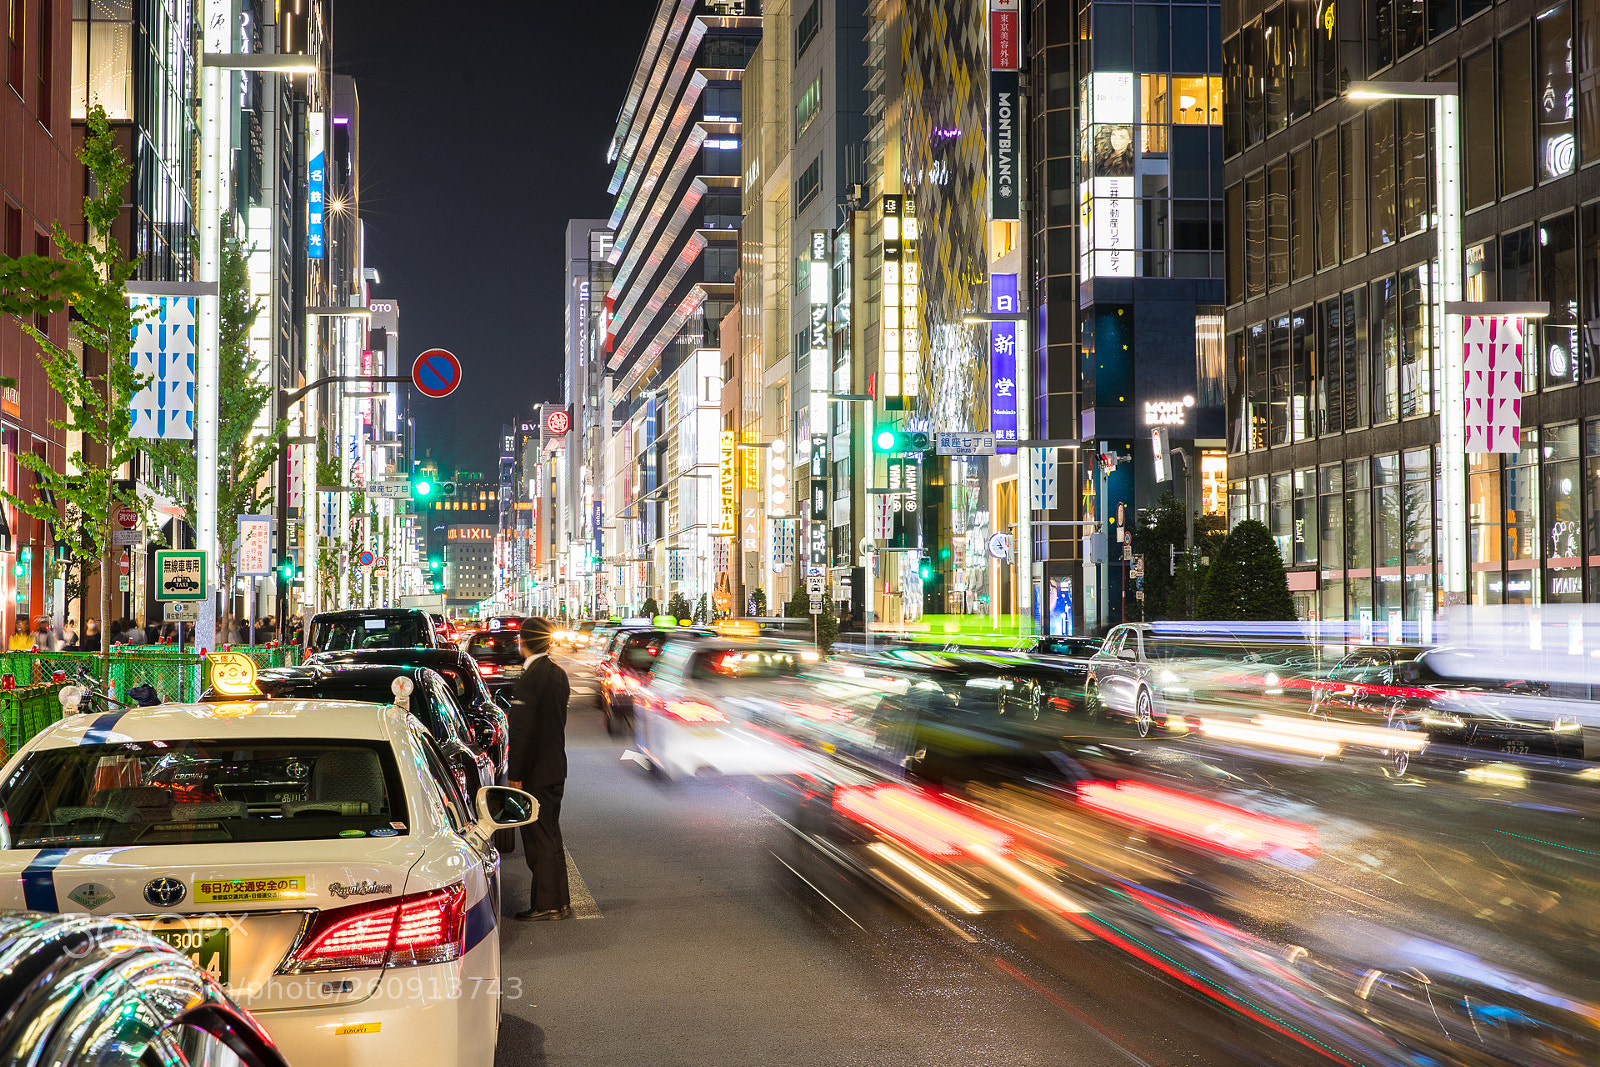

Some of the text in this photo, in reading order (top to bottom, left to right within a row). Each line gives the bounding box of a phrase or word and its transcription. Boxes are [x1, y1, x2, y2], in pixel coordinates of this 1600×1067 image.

[1000, 14, 1009, 67] 東京美容外科
[999, 92, 1011, 184] MONTBLANC
[1109, 180, 1119, 272] 三井不動産リアルティ
[812, 307, 827, 346] ダンス
[994, 295, 1015, 397] 日新堂
[1145, 402, 1183, 413] MONT
[1145, 413, 1185, 424] BLANC
[995, 430, 1015, 440] 銀座
[940, 438, 992, 447] 銀座七丁目
[369, 485, 408, 493] 銀座七丁目
[119, 513, 137, 521] 消火栓
[460, 528, 491, 539] LIXIL
[163, 559, 199, 573] 無線車専用
[221, 655, 237, 663] 個人
[201, 880, 298, 895] 毎日が交通安全の日
[174, 933, 203, 949] 300
